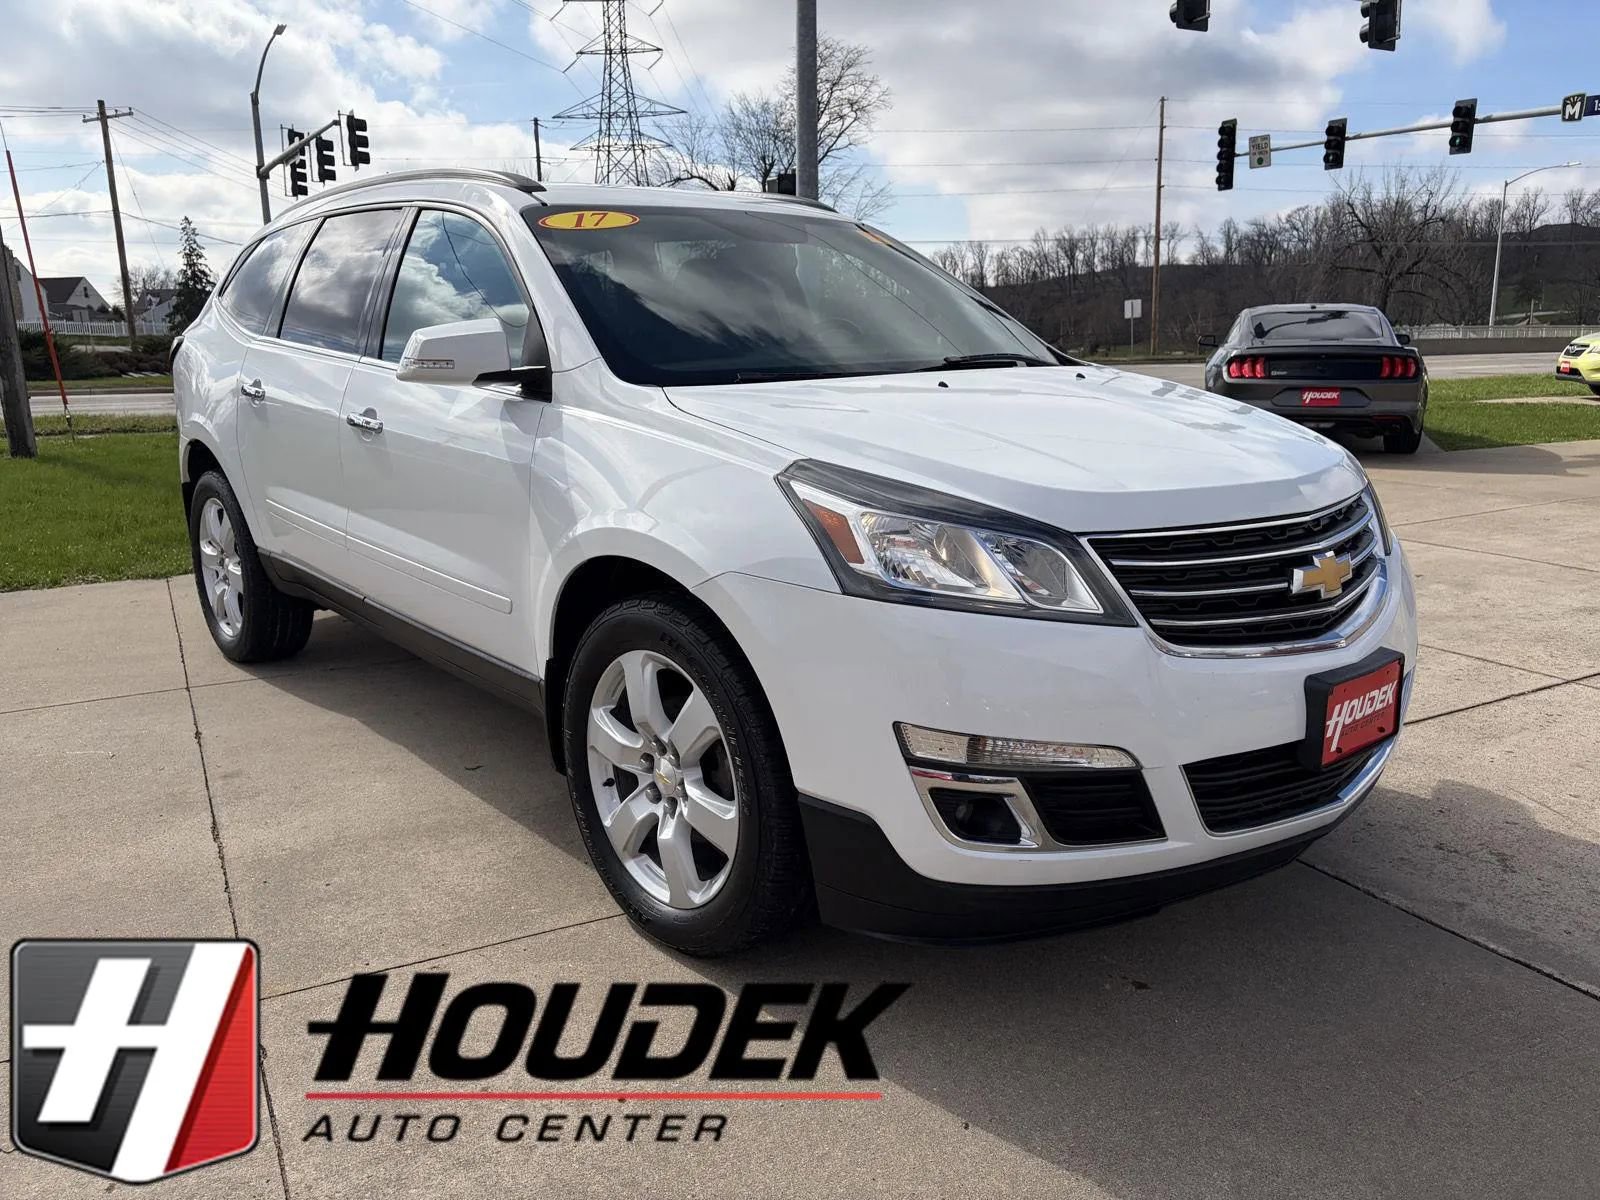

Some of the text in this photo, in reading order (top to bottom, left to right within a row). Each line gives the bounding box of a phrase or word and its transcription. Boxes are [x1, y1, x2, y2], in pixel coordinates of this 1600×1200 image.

[1252, 142, 1269, 150] YIELD
[571, 212, 608, 228] 17
[1302, 391, 1339, 403] HOUDEK
[1326, 680, 1398, 752] HOUDEK
